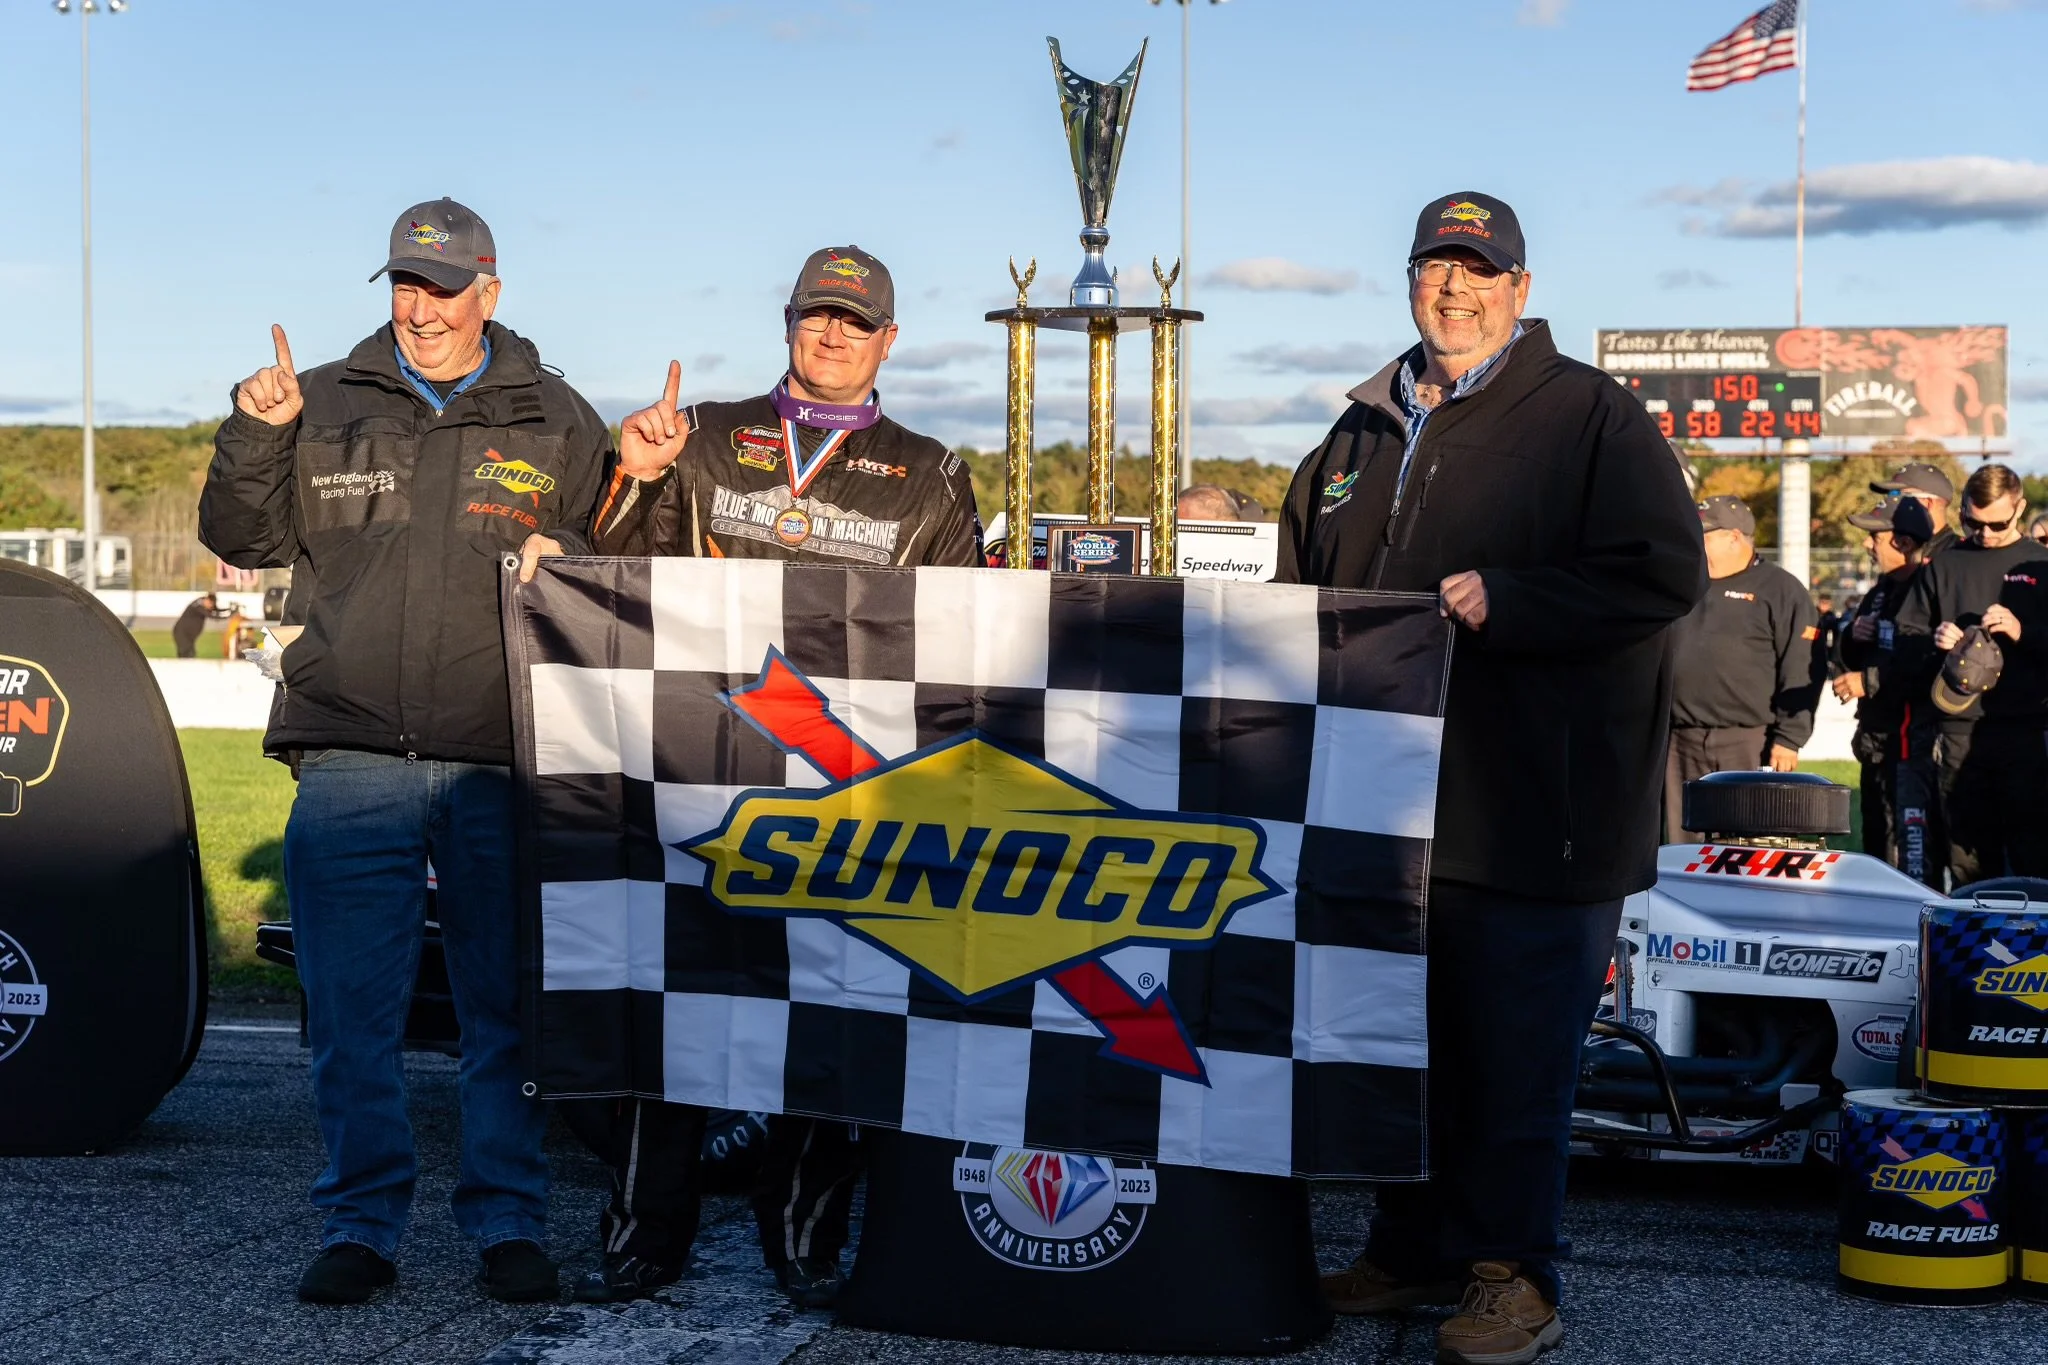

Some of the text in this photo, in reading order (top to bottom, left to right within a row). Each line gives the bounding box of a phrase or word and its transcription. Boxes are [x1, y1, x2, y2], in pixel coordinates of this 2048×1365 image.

[1437, 226, 1493, 239] RACE FUELS
[1713, 374, 1759, 402] 150
[812, 411, 858, 422] HOOSIER
[1686, 410, 1722, 438] 58
[1740, 410, 1776, 437] 22
[1784, 411, 1822, 436] 44
[752, 429, 783, 440] NASCAR
[311, 472, 374, 488] New England
[478, 464, 555, 492] SUNOCO
[320, 486, 365, 500] Racing Fuel
[466, 502, 512, 517] RACE
[712, 487, 750, 521] BLUE
[832, 519, 898, 551] MACHINE
[1073, 542, 1116, 550] WORLD
[1181, 557, 1264, 576] Speedway
[725, 814, 1236, 929] SUNOCO
[1647, 933, 1727, 963] Mobil
[1646, 957, 1675, 966] OFFICIAL
[1676, 960, 1700, 968] MOTOR
[1719, 963, 1760, 973] LUBRICANTS
[1769, 951, 1883, 977] COMETIC
[7, 993, 41, 1005] 2023
[1860, 1030, 1893, 1045] TOTAL
[1968, 1025, 2041, 1044] RACE
[958, 1168, 986, 1183] 1948
[1876, 1167, 1992, 1191] SUNOCO
[1121, 1179, 1151, 1193] 2023
[973, 1202, 1132, 1265] ANNIVERSARY
[1866, 1220, 2000, 1243] RACE FUELS
